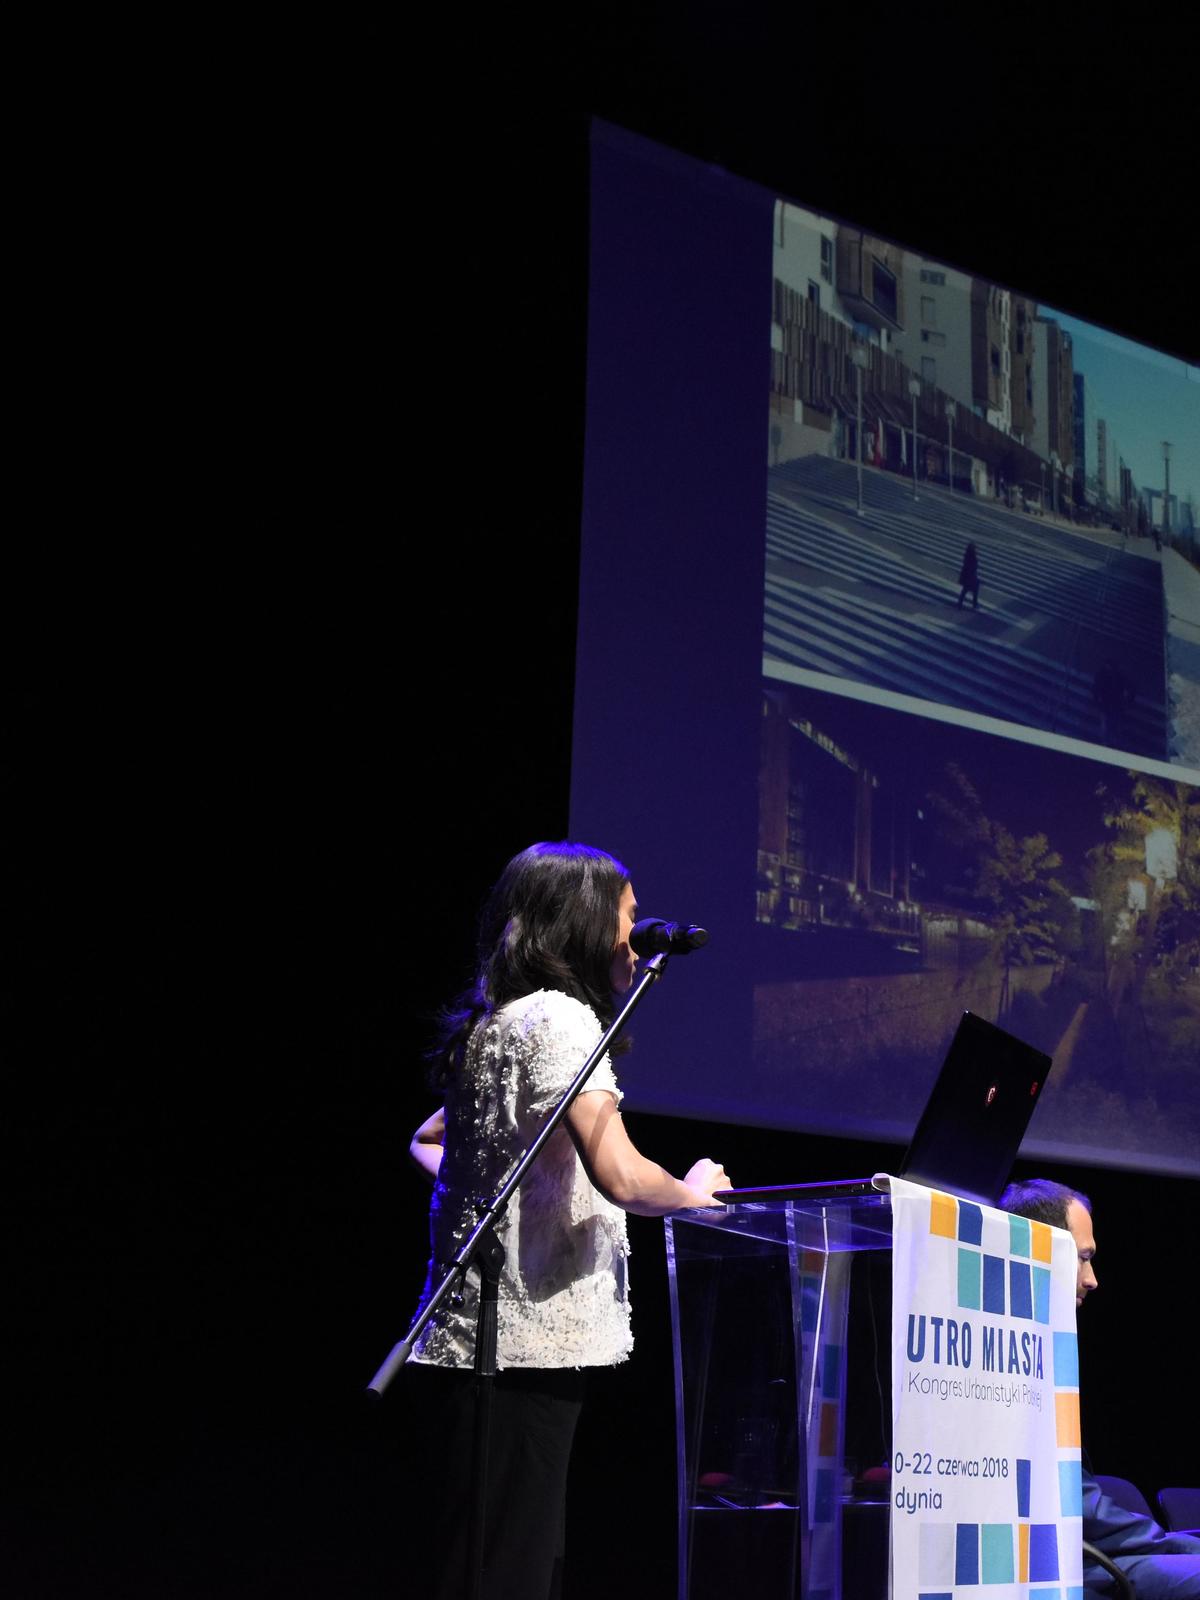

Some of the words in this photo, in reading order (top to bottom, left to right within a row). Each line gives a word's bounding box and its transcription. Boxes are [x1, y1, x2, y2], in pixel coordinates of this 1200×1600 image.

[907, 1313, 972, 1369] UTRO
[982, 1326, 1044, 1380] MIASTA
[908, 1371, 963, 1401] Kongres
[964, 1377, 1020, 1408] Urbanistyki
[894, 1451, 932, 1475] 0-22
[937, 1458, 979, 1477] czerwca
[982, 1457, 1009, 1478] 2018
[895, 1486, 943, 1515] dynia
